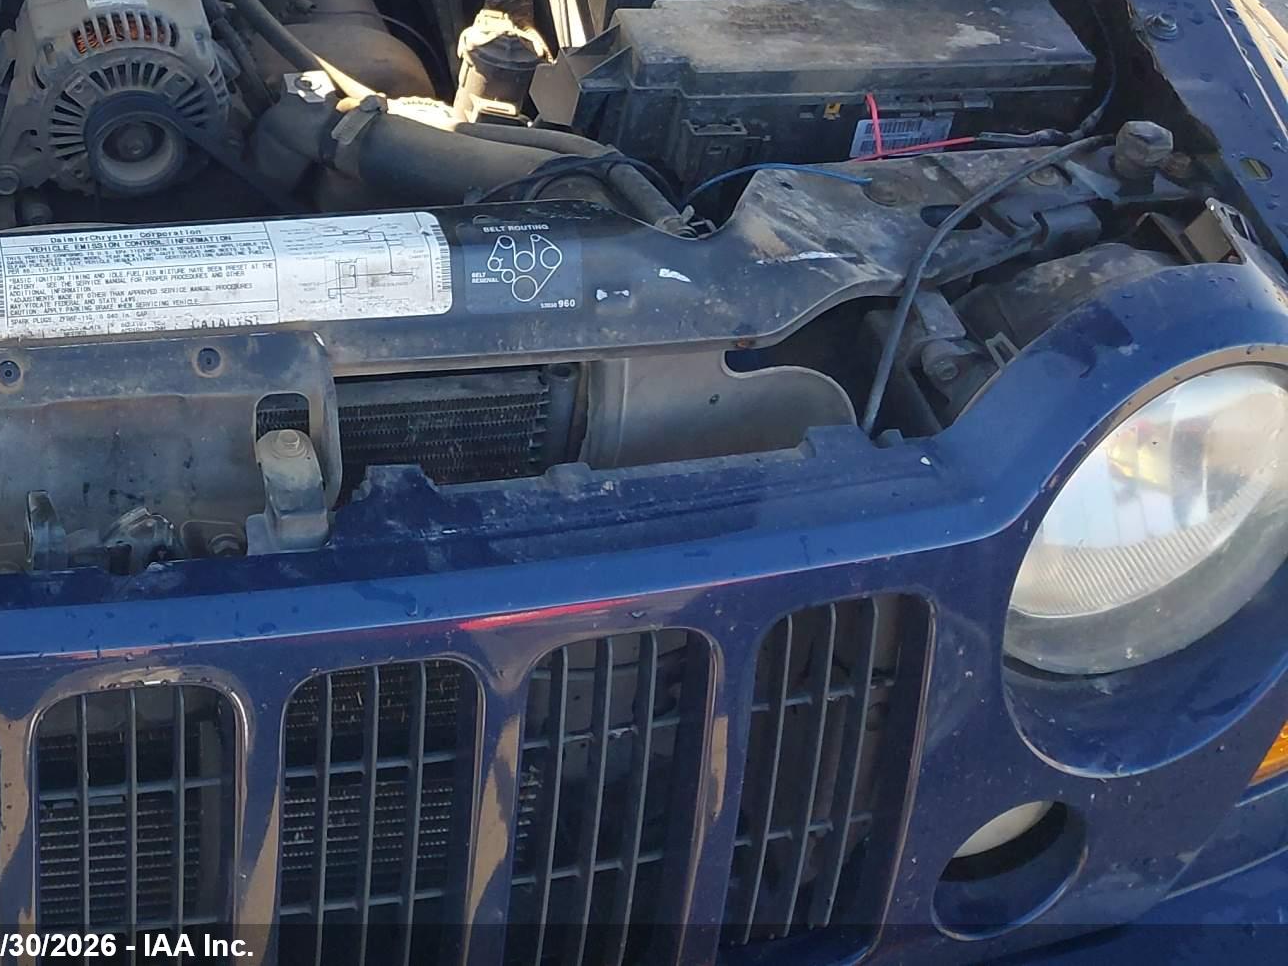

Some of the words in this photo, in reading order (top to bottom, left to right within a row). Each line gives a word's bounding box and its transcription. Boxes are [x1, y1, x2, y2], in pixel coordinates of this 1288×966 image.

[508, 224, 549, 232] ROUTING
[49, 233, 132, 243] DaimlerChrysler
[139, 229, 202, 238] Corporation
[28, 244, 68, 252] VEHICLE
[73, 241, 119, 249] EMISSION
[170, 235, 232, 244] INFORMATION
[170, 272, 208, 280] PROCEDURES
[135, 299, 169, 307] SERVICING
